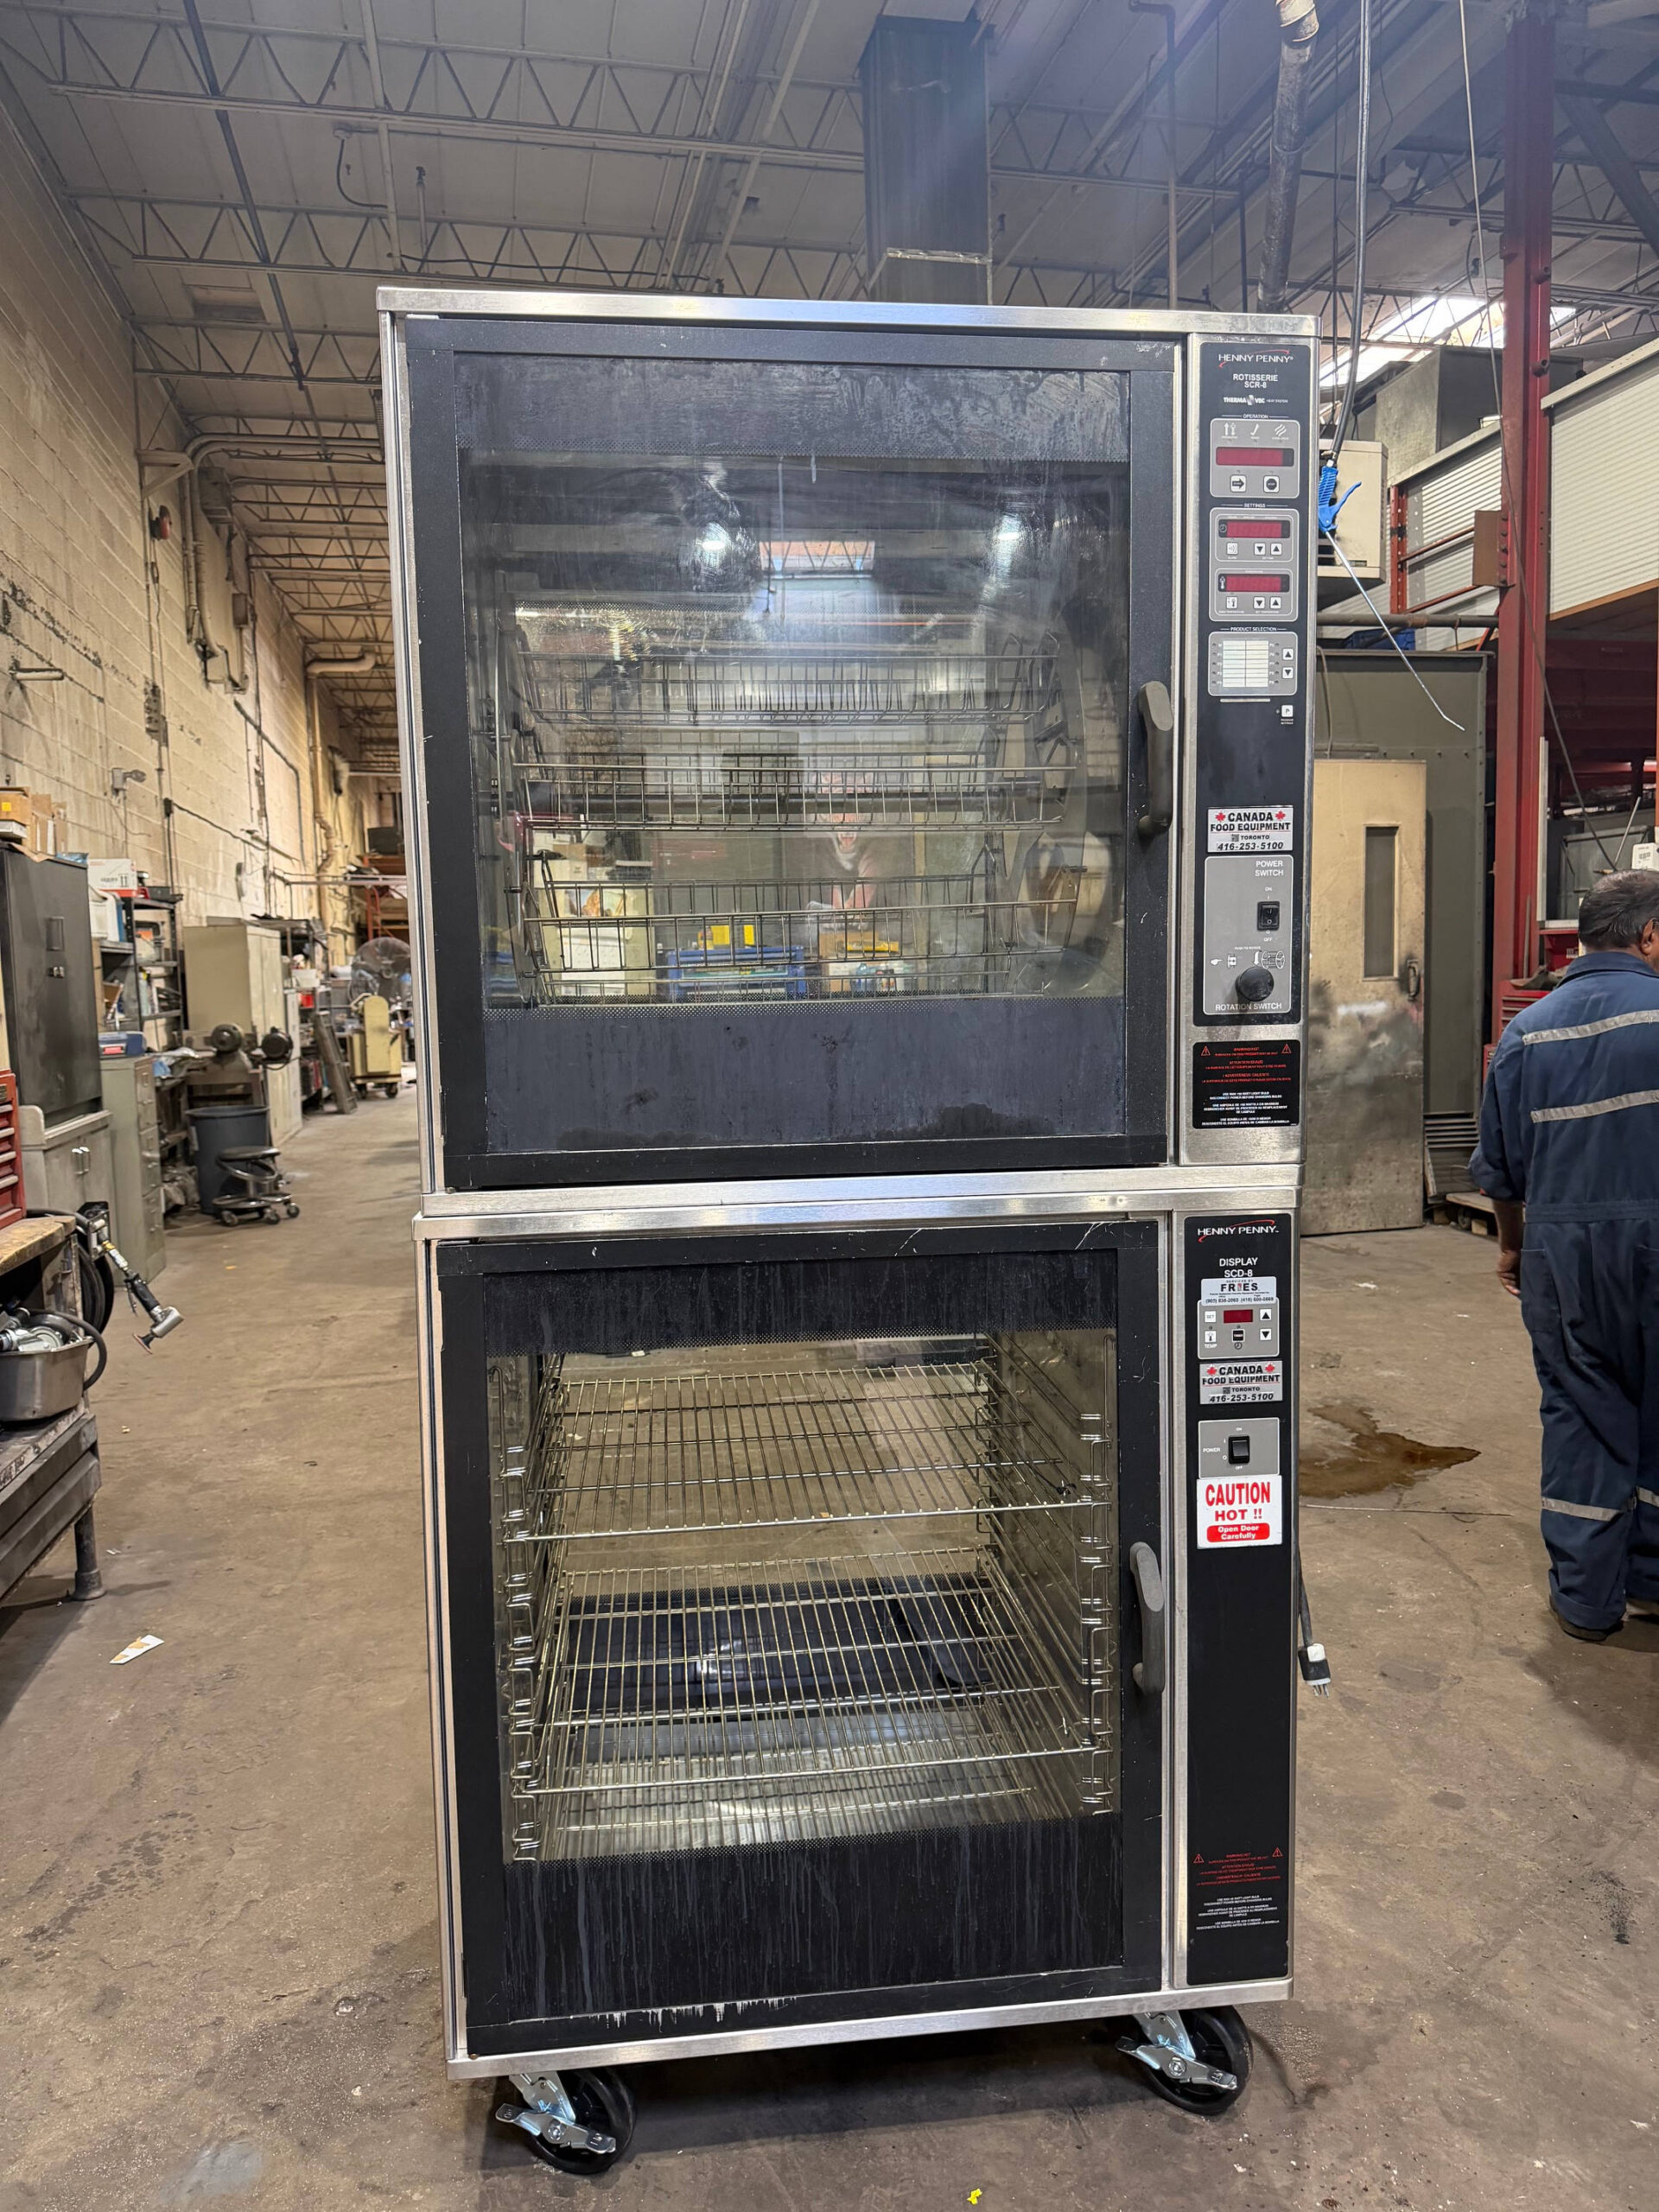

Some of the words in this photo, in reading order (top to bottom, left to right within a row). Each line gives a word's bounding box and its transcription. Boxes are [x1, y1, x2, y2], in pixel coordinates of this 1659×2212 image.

[1218, 353, 1253, 363] HENNY
[1256, 354, 1290, 363] PENNY
[1232, 373, 1279, 382] ROTISSERIE
[1228, 812, 1274, 823] CANADA
[1237, 823, 1291, 831] EQUIPMENT
[1217, 842, 1284, 850] 416-253-5100
[1198, 1227, 1236, 1236] HENNY
[1239, 1225, 1276, 1234] PENNY
[1219, 1257, 1258, 1267] DISPLAY
[1224, 1269, 1253, 1278] SCD-8
[1219, 1365, 1263, 1375] CANADA
[1229, 1375, 1281, 1384] EQUIPMENT
[1210, 1393, 1274, 1402] 416-253-5100
[1205, 1481, 1271, 1507] CAUTION
[1215, 1510, 1248, 1522] HOT
[1254, 1509, 1262, 1520] !!
[1221, 1532, 1256, 1541] Carefully
